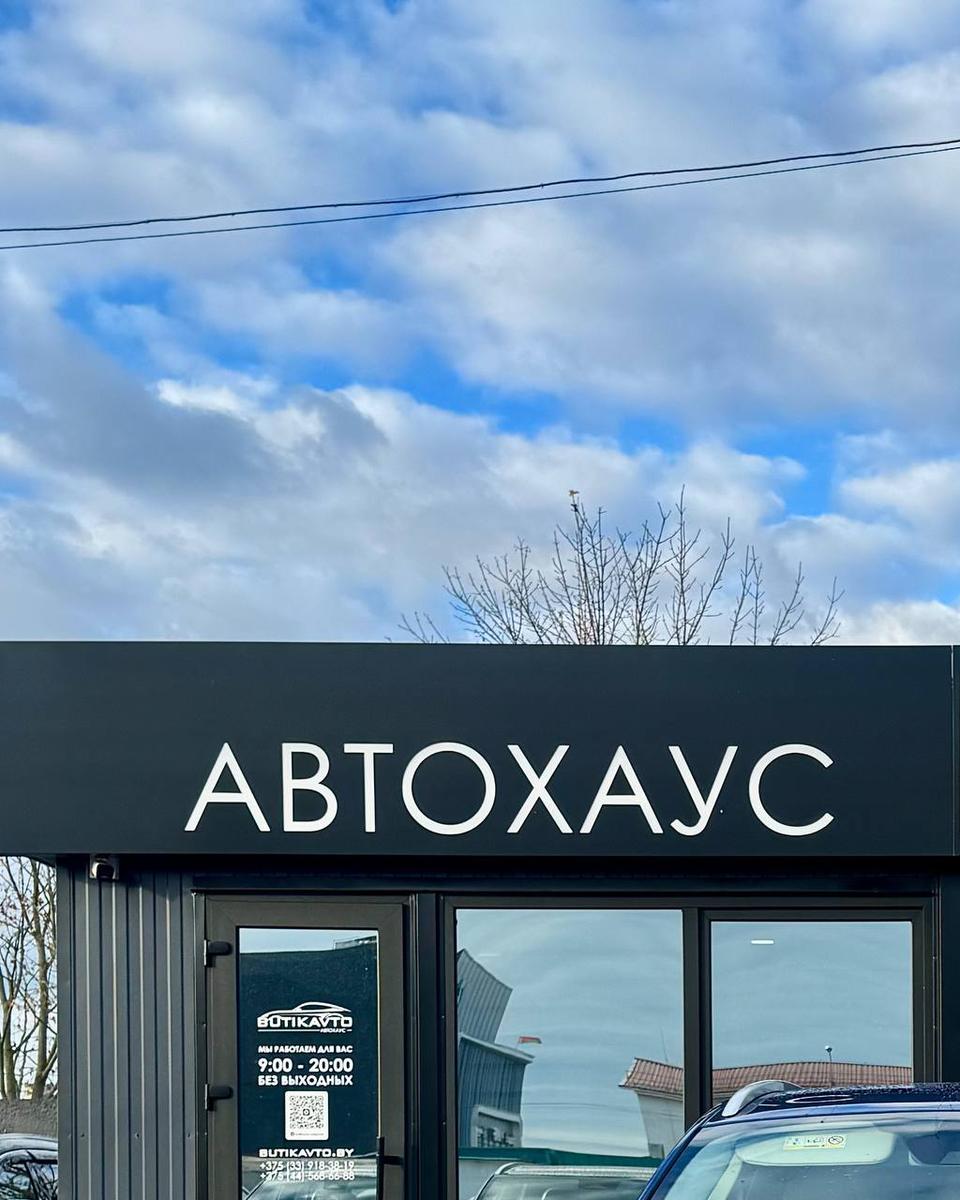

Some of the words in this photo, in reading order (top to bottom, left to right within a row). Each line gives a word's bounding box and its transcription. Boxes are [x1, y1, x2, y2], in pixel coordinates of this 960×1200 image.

[185, 742, 834, 838] АВТОХАУС
[257, 1016, 353, 1028] BUTIKAVTO
[258, 1058, 292, 1073] 9:00
[309, 1058, 353, 1073] 20:00
[258, 1075, 278, 1086] БЕЗ
[282, 1075, 353, 1086] ВЫХОДНЫХ
[259, 1148, 354, 1157] BUTIKAVTO.BY
[260, 1161, 284, 1170] +375
[287, 1161, 304, 1172] (33)
[307, 1160, 354, 1170] 918-38-19
